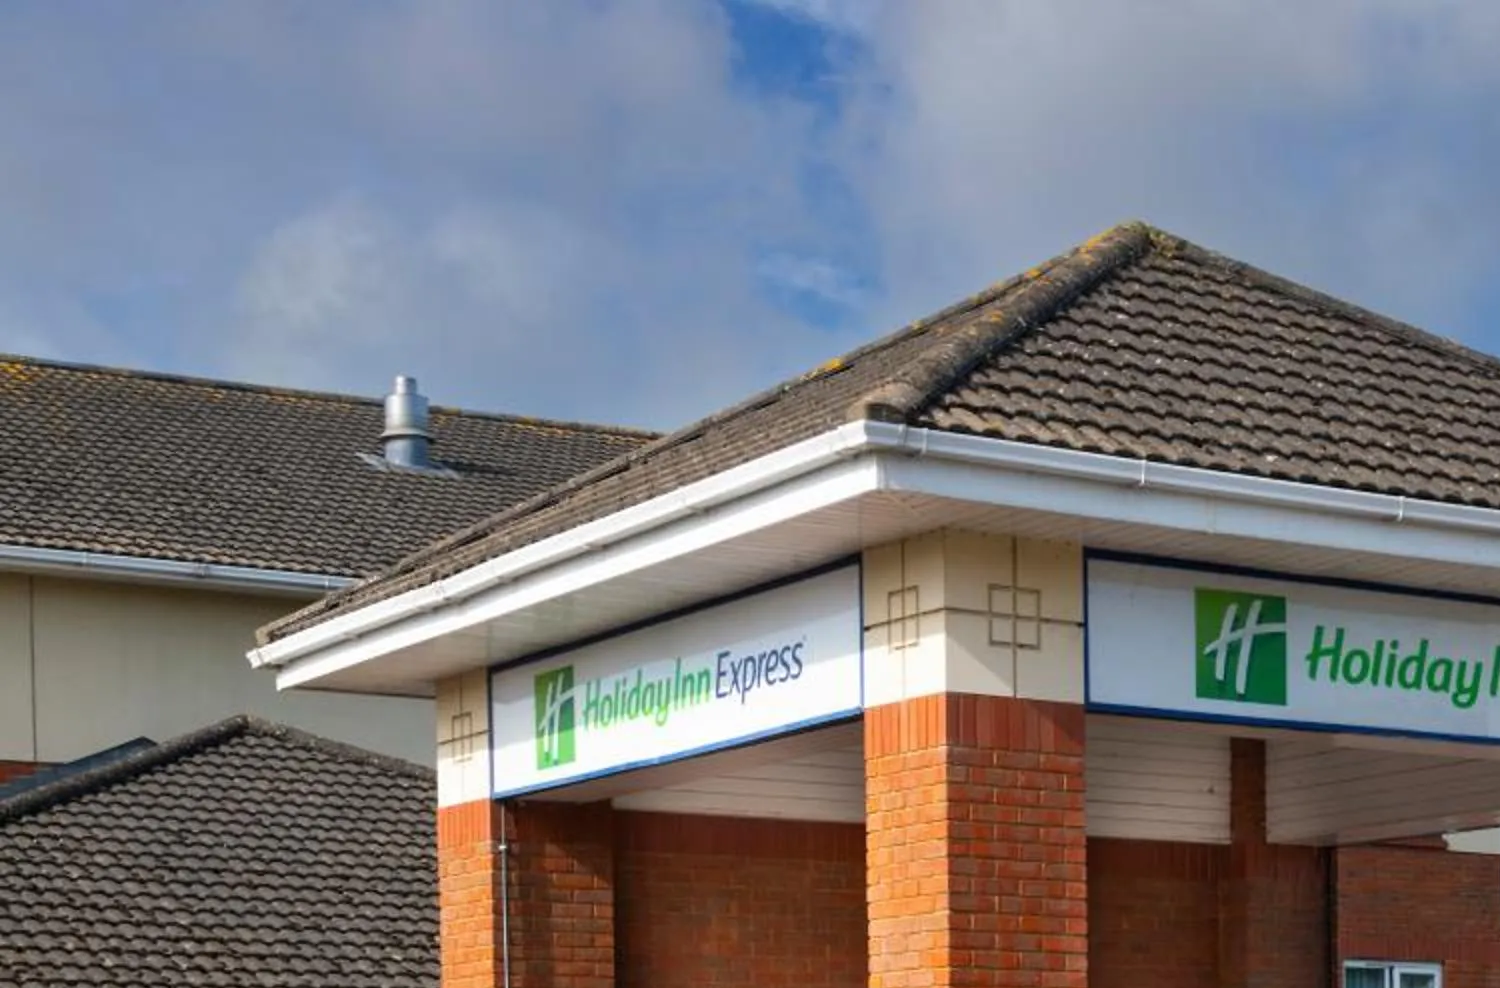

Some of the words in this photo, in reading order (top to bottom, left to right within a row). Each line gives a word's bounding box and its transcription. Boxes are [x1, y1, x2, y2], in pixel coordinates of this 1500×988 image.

[582, 668, 672, 733] Holiday
[673, 656, 711, 712] Inn
[715, 642, 804, 704] Express
[1306, 625, 1483, 709] Holiday
